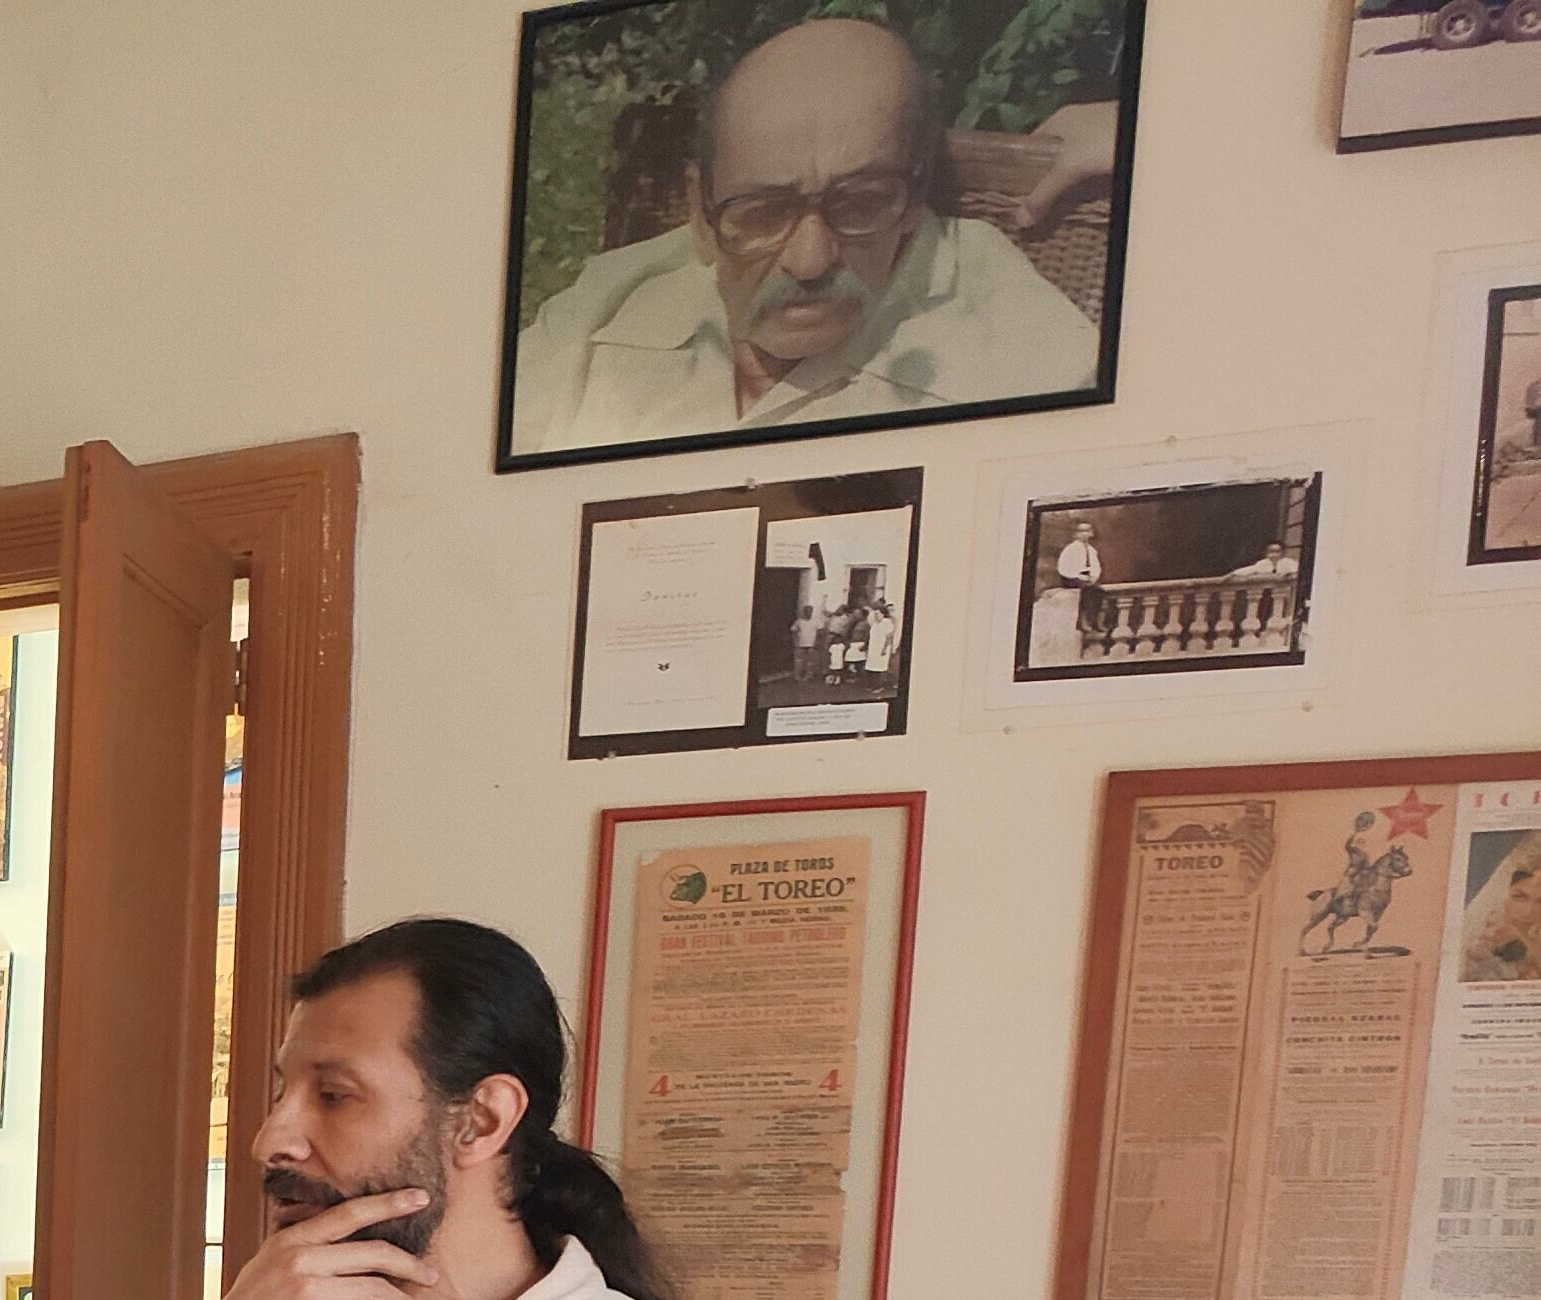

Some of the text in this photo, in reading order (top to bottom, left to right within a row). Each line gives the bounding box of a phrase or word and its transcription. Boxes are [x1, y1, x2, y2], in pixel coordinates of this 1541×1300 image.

[730, 857, 835, 875] PLAZA DE TOROS
[1154, 855, 1224, 871] TOREO
[648, 1075, 671, 1097] 4
[818, 1068, 842, 1092] 4
